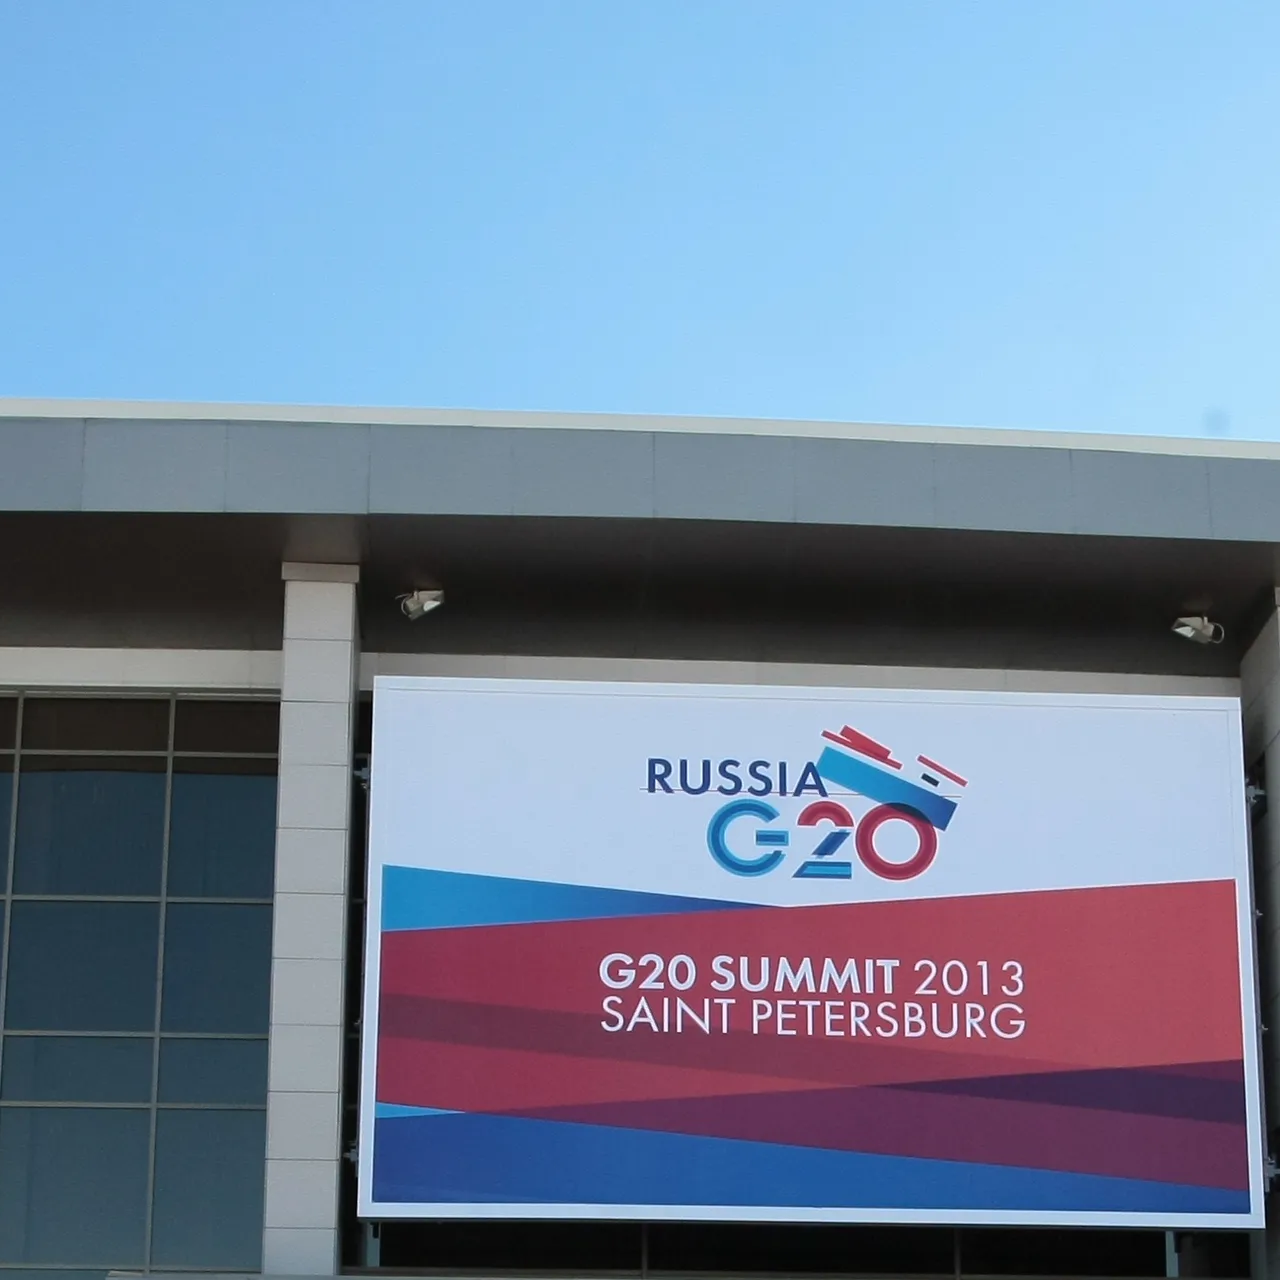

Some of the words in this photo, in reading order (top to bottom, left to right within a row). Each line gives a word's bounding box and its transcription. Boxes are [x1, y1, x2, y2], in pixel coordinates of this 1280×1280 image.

[647, 757, 829, 798] RUSSIA
[706, 799, 938, 881] G20
[599, 952, 697, 991] G20
[710, 954, 900, 995] SUMMIT
[914, 959, 1025, 997] 2013
[600, 995, 737, 1035] SAINT
[751, 999, 1026, 1039] PETERSBURG
